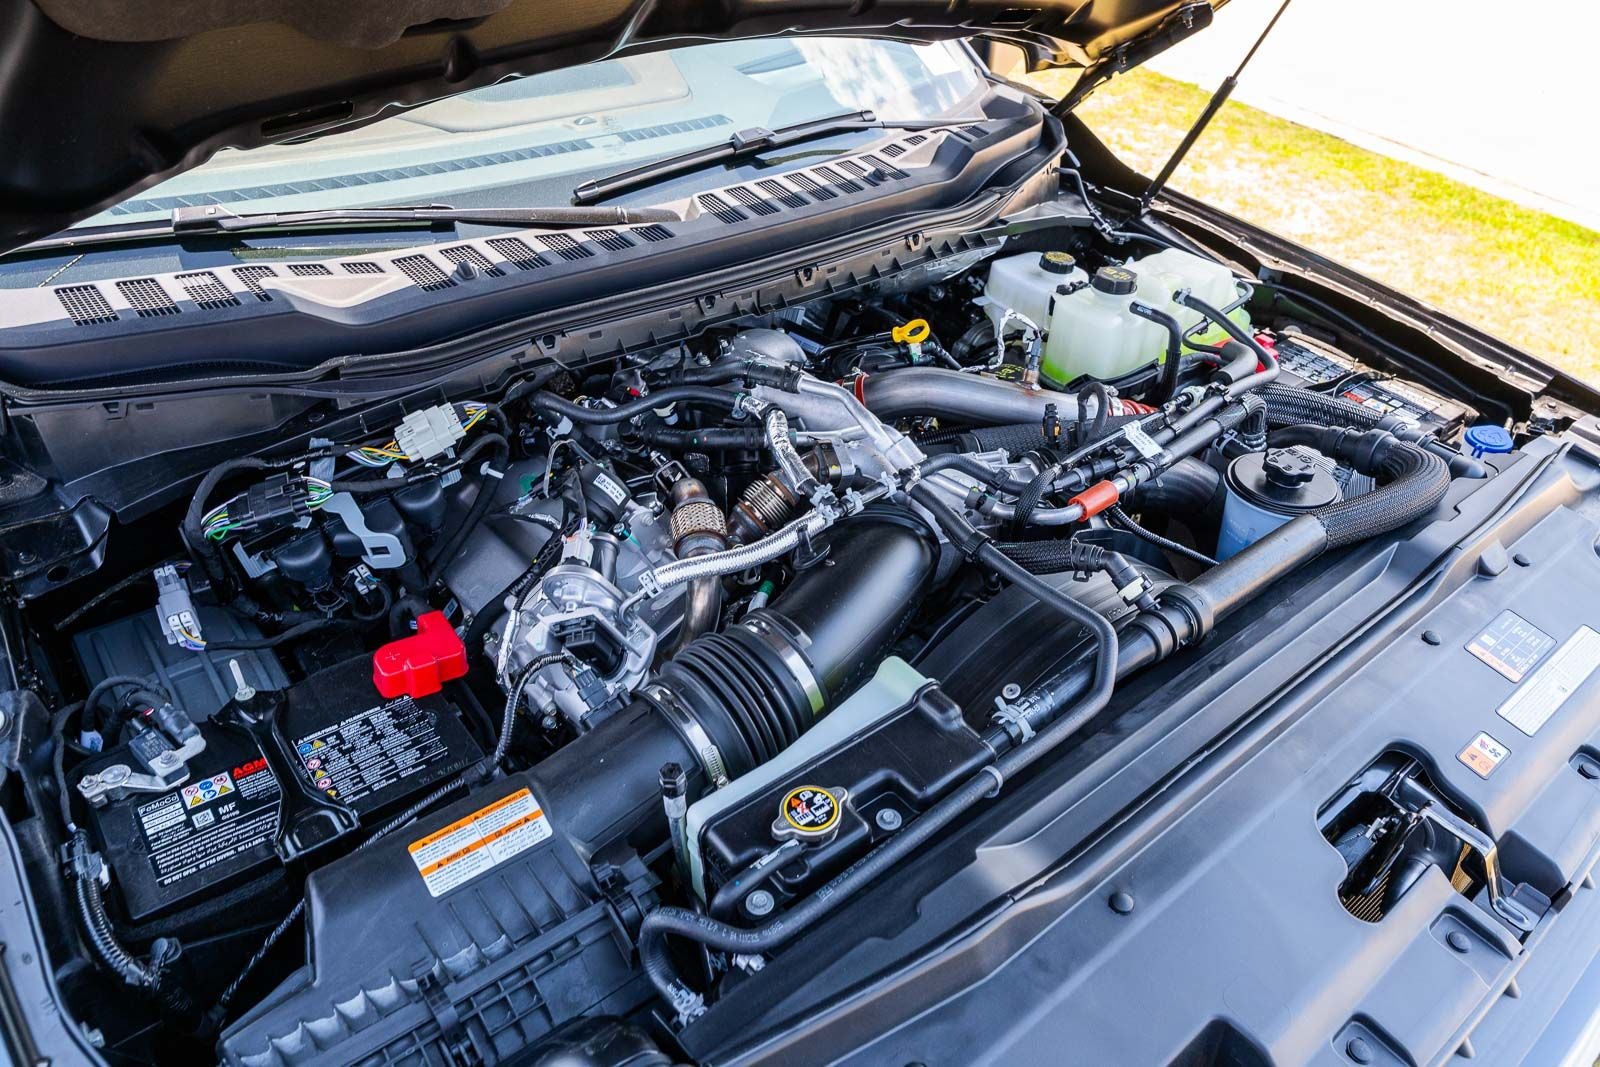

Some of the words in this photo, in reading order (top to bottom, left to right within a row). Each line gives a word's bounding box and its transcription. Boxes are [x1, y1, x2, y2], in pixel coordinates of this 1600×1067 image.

[233, 757, 268, 778] AGM
[139, 796, 178, 814] FoMoCo
[218, 802, 236, 815] MF
